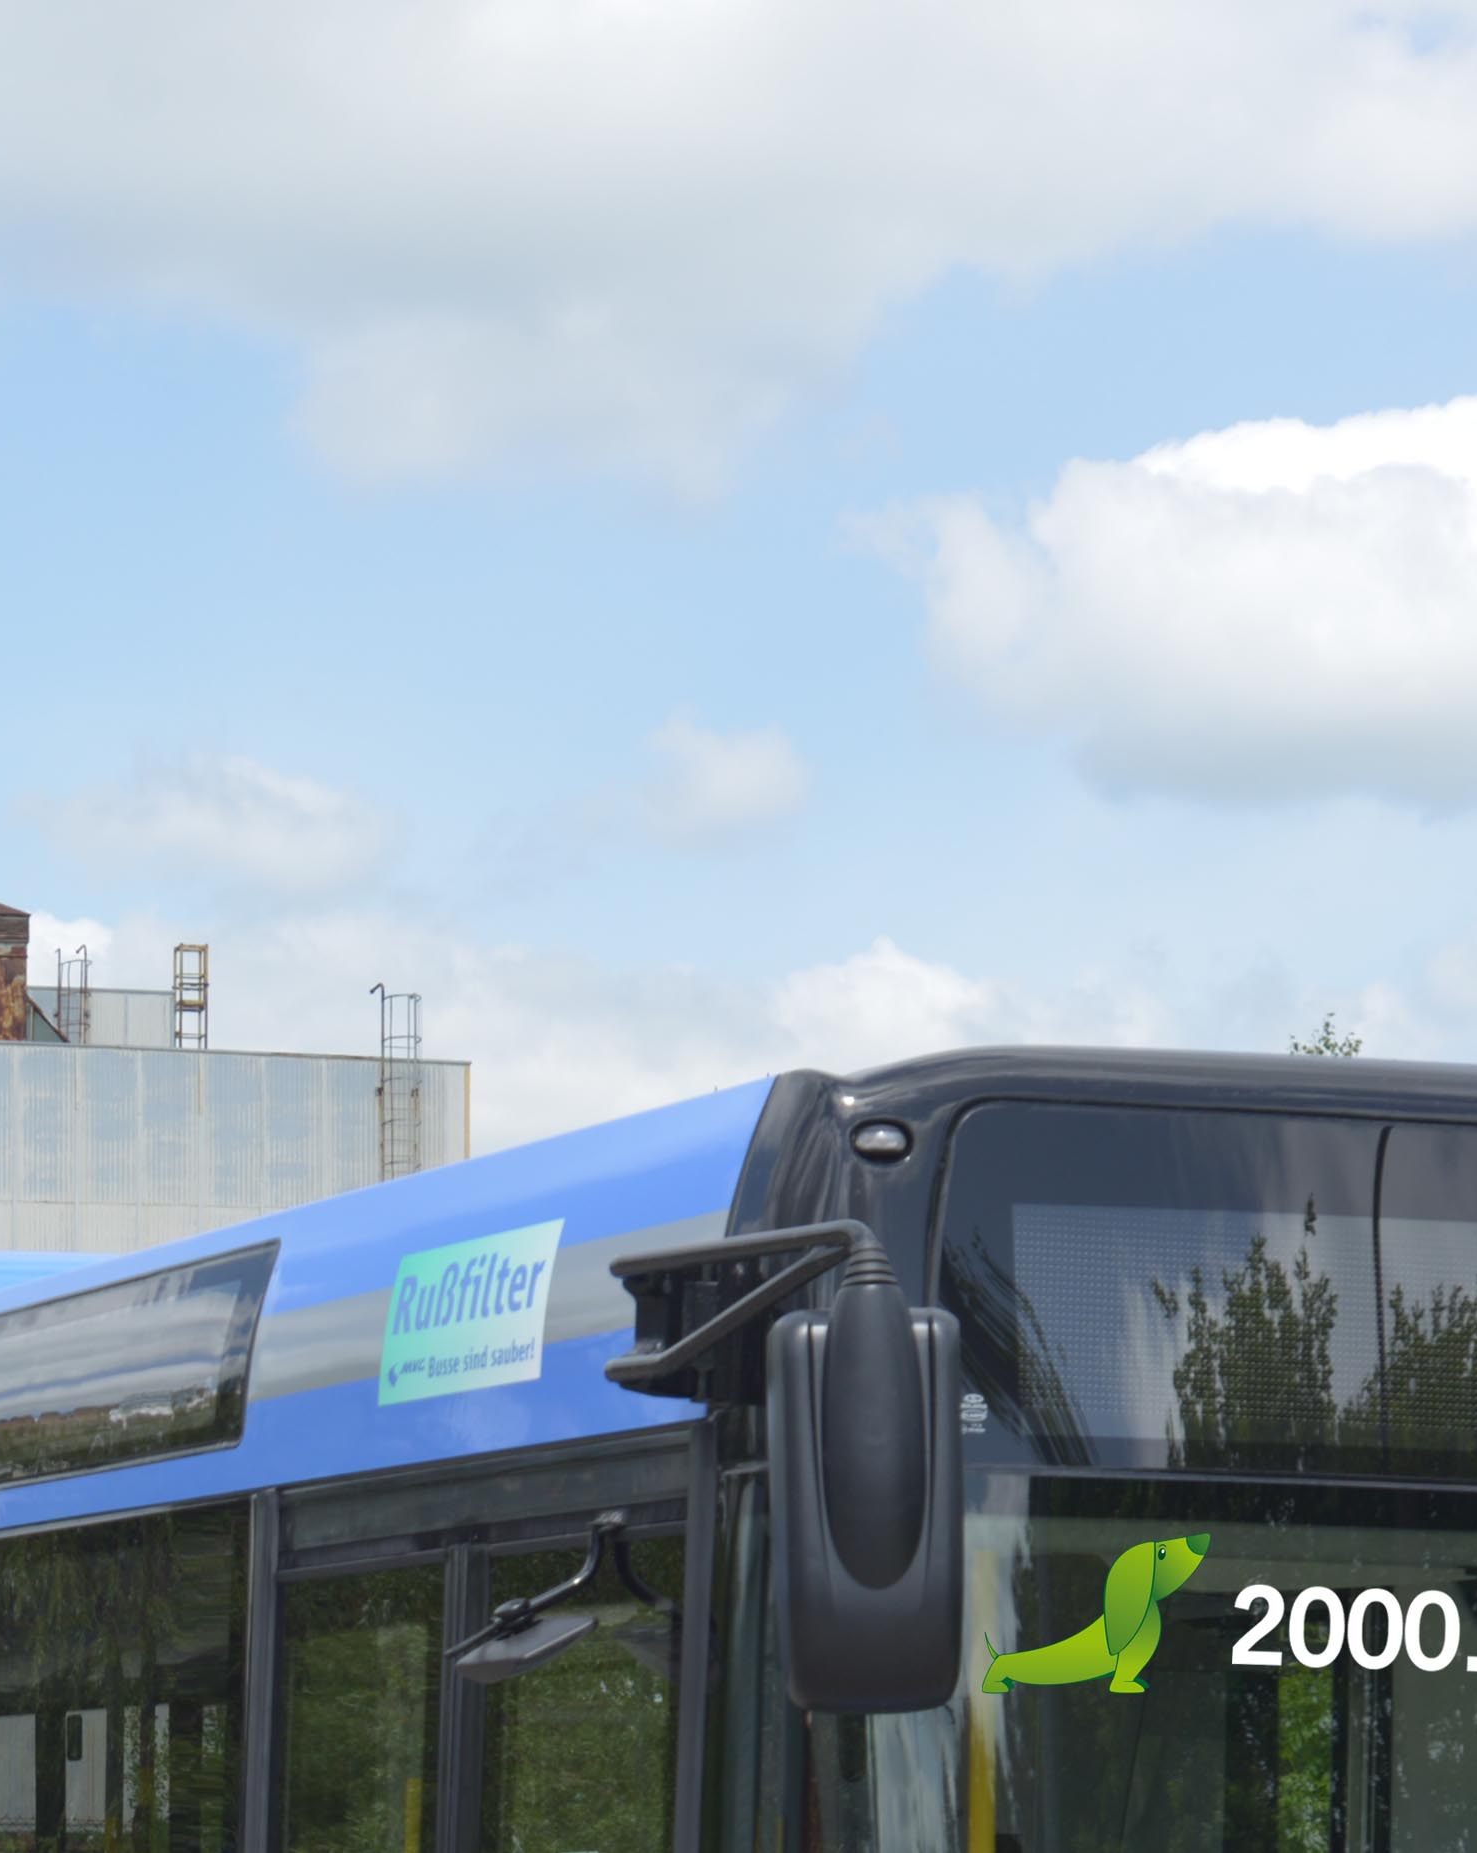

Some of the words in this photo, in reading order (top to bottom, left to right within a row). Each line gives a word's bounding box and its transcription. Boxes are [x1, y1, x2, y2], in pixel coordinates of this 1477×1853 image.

[392, 1253, 546, 1336] Rußfilter
[428, 1356, 459, 1378] Busse
[462, 1346, 488, 1372] sind
[491, 1338, 535, 1367] sauber!
